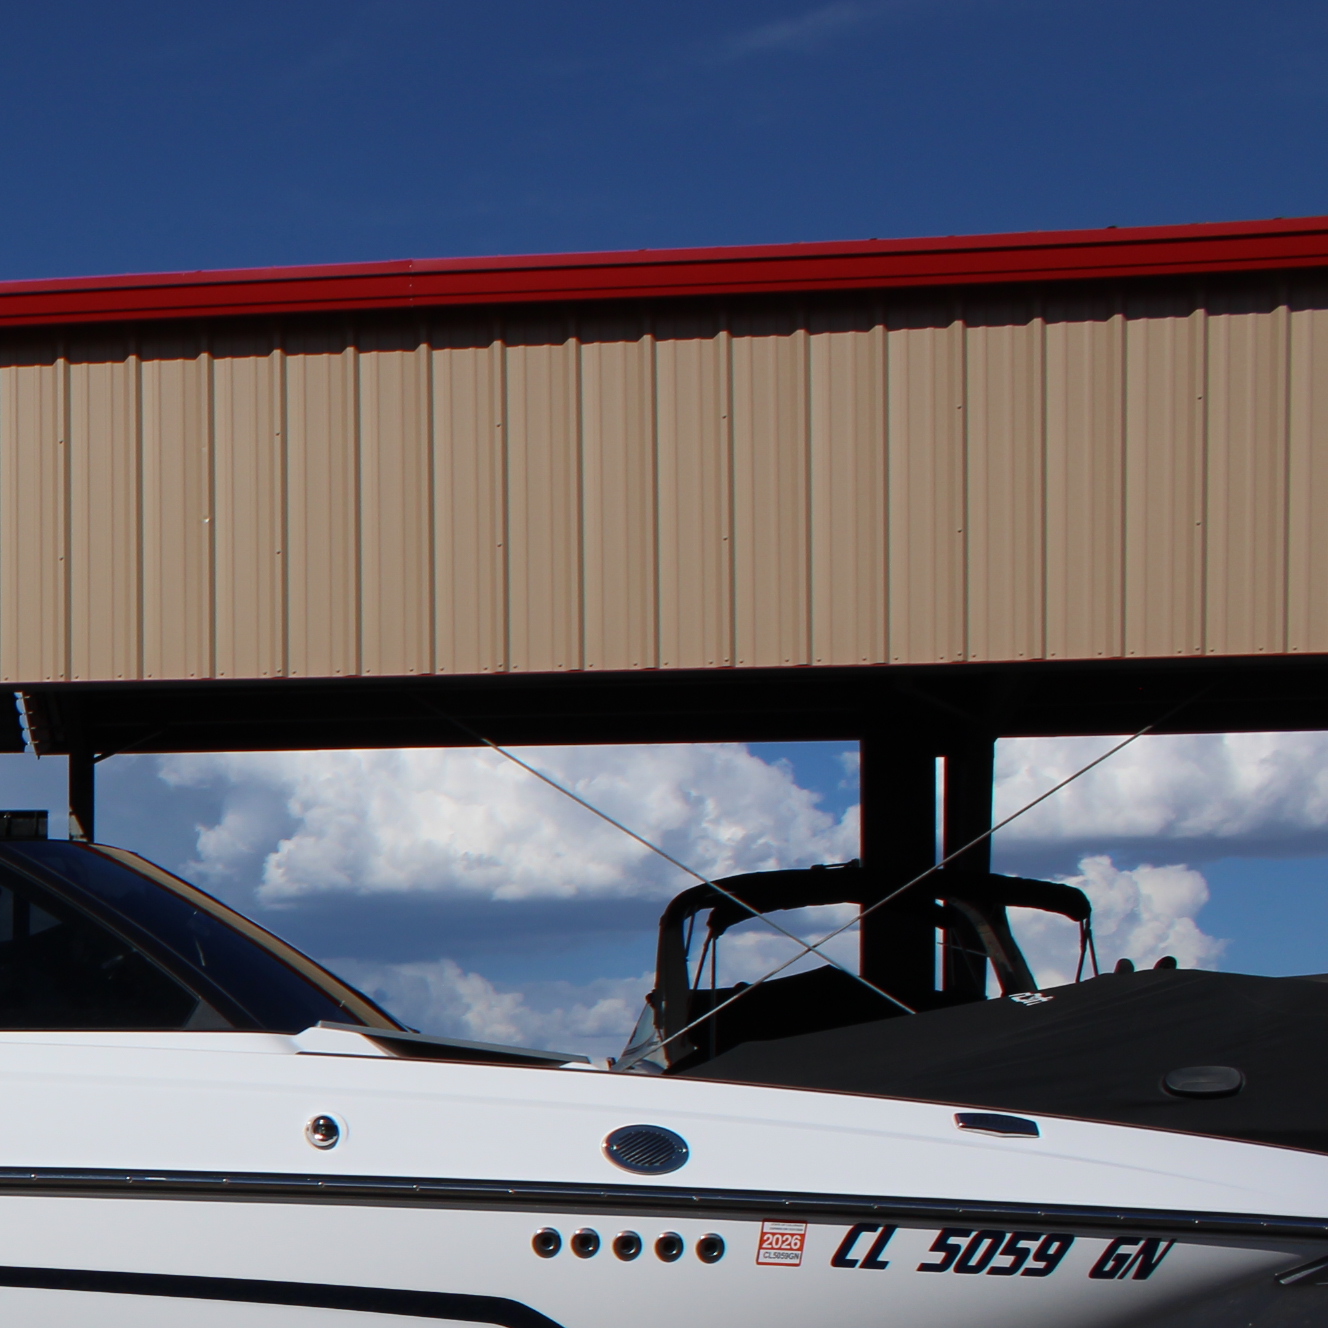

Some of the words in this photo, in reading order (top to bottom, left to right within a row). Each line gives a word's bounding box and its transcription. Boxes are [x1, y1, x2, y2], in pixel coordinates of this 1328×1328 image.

[761, 1233, 802, 1249] 2026
[762, 1251, 800, 1260] CL5059GN
[830, 1222, 898, 1270] CL
[915, 1227, 1075, 1278] 5059
[1087, 1236, 1177, 1280] GN
